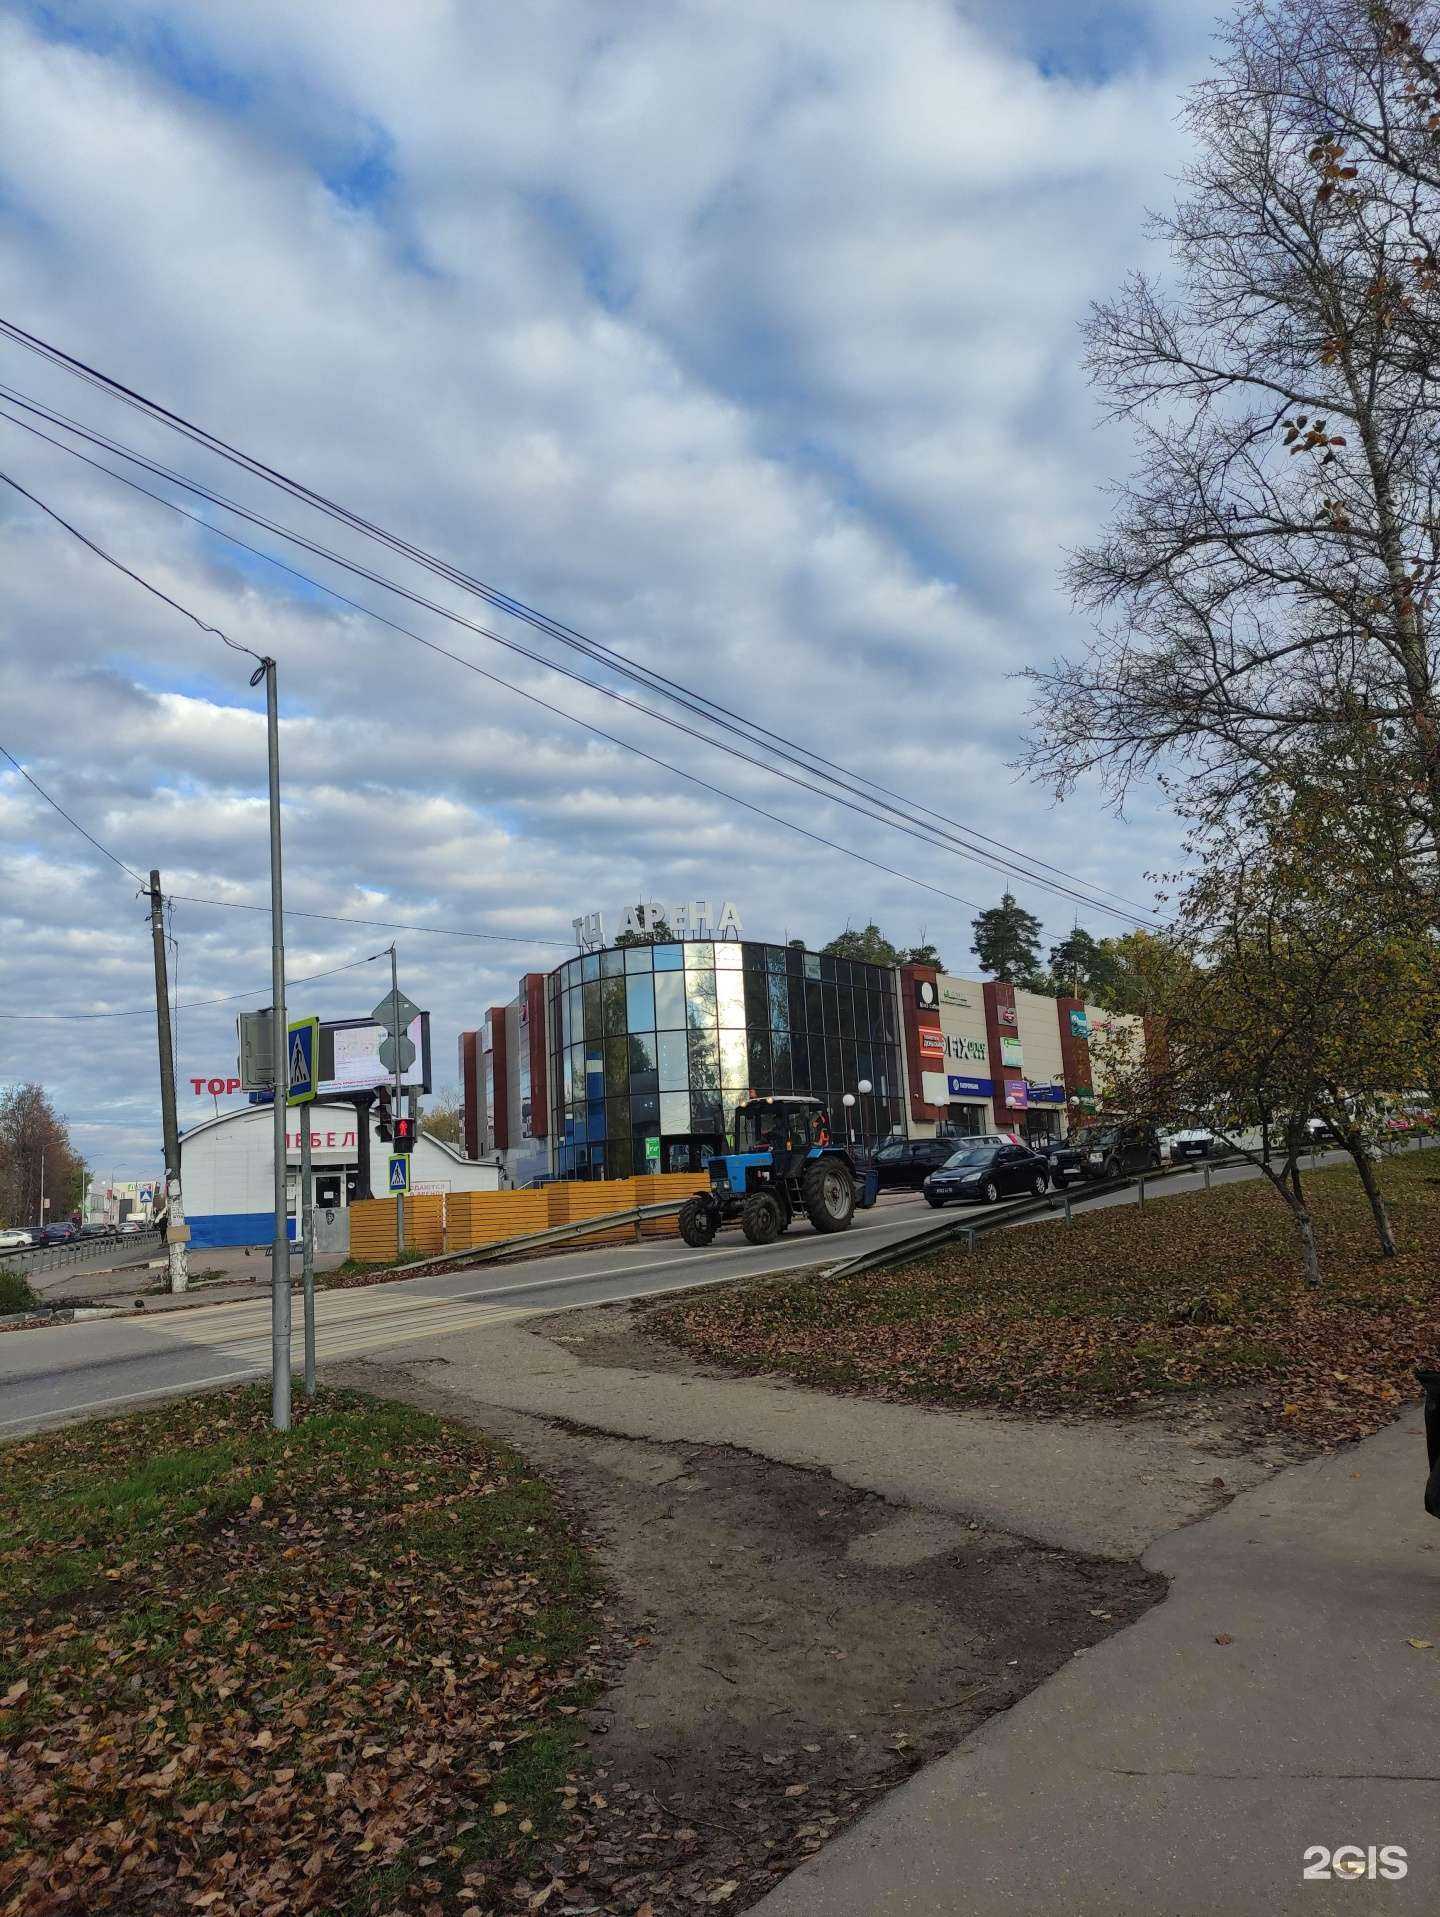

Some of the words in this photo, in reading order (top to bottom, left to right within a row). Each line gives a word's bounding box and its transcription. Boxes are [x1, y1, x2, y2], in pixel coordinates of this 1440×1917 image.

[572, 911, 606, 947] ТЦ
[619, 901, 745, 932] АРЕНА
[190, 1078, 242, 1096] ТОР
[286, 1131, 355, 1149] ЕБЕЛ
